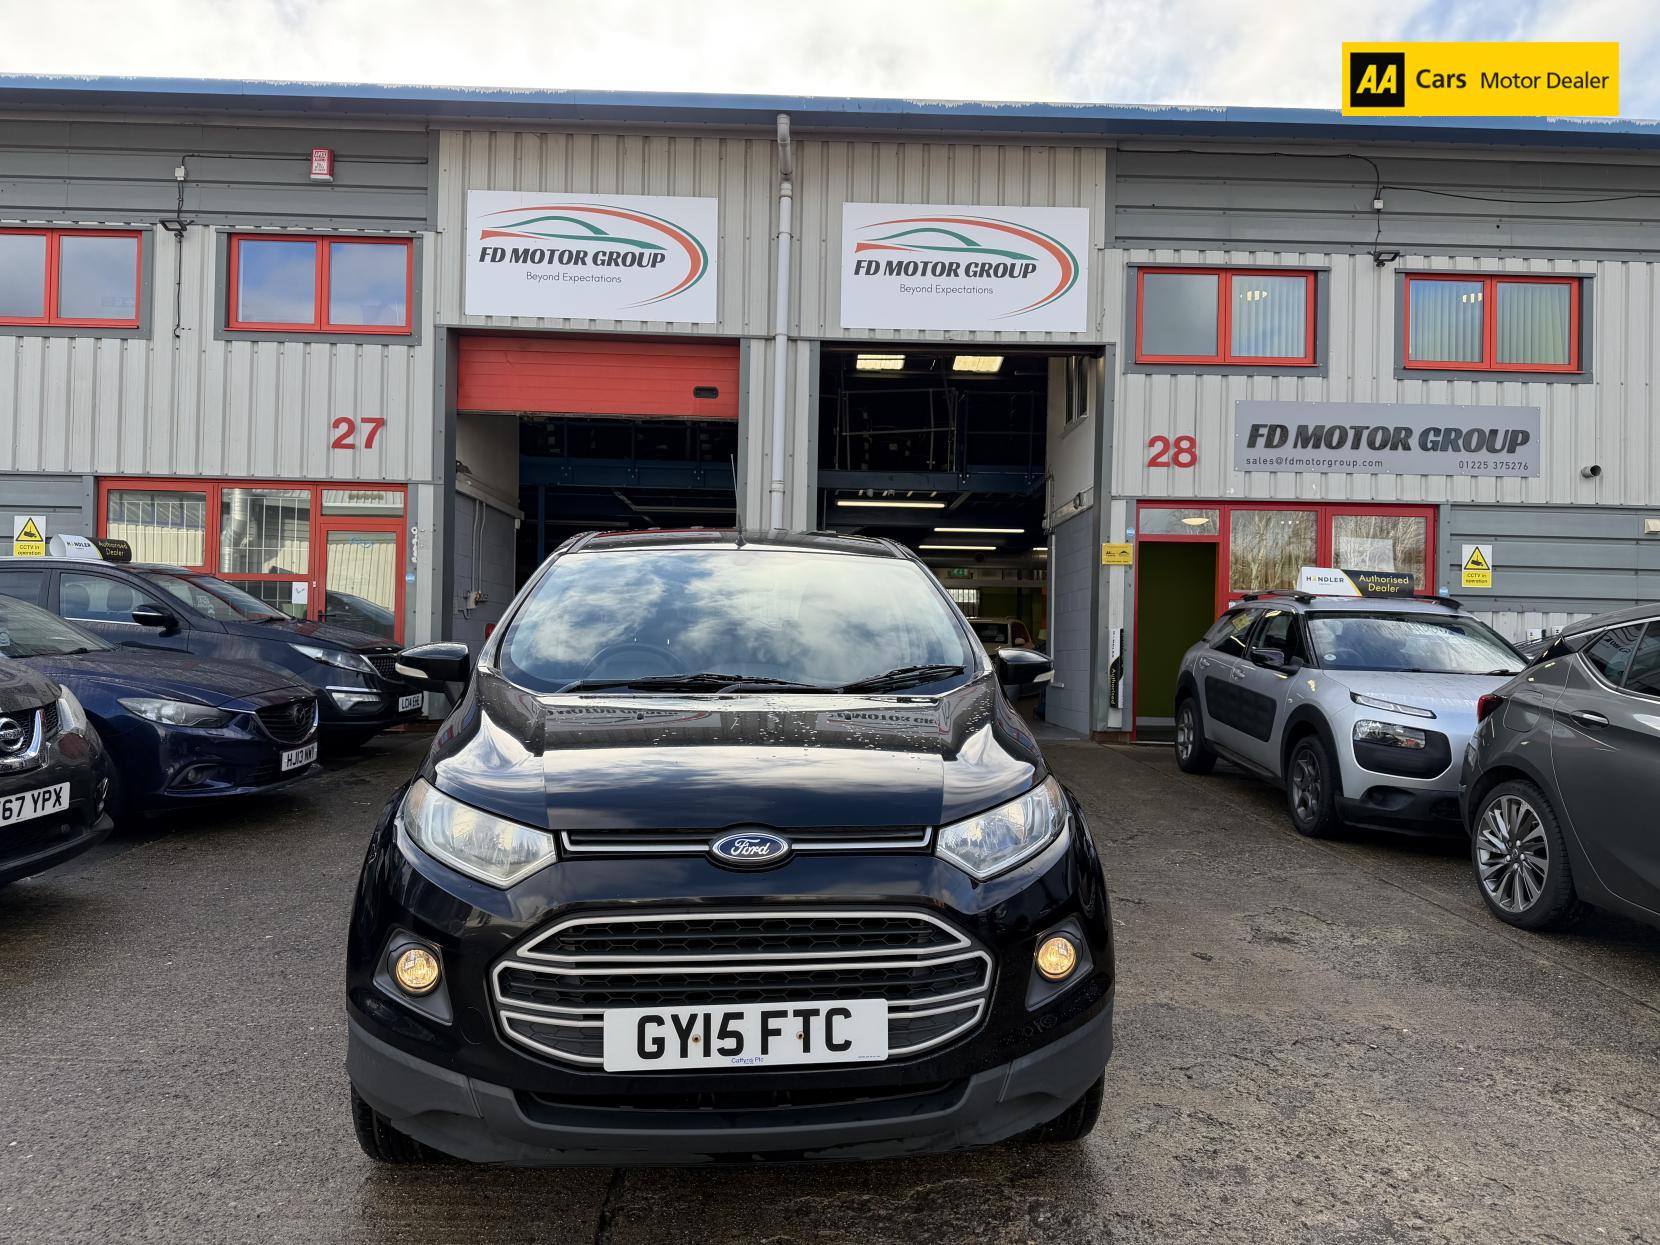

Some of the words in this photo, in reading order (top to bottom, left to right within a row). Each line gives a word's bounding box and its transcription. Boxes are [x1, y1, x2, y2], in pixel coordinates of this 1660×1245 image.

[479, 246, 505, 262] FD
[510, 248, 587, 266] MOTOR
[592, 251, 666, 269] GROUP
[526, 271, 560, 283] Beyond
[563, 272, 622, 284] Expectations
[854, 259, 880, 276] FD
[884, 261, 960, 278] MOTOR
[964, 262, 1037, 279] GROUP
[900, 284, 933, 295] Beyond
[936, 284, 994, 296] Expectations
[331, 416, 385, 449] 27
[1246, 423, 1289, 449] FD
[1293, 424, 1413, 451] MOTOR
[1418, 426, 1531, 454] GROUP
[1147, 435, 1197, 468] 28
[1246, 456, 1383, 468] sales@fdmotorgroup.com
[1458, 459, 1489, 470] 01225
[1493, 460, 1529, 471] 375276
[105, 548, 124, 557] Dealer
[1359, 574, 1409, 585] Authorised
[1368, 583, 1400, 593] Dealer
[0, 796, 25, 821] 67
[31, 786, 63, 813] YPX
[731, 838, 771, 855] Ford
[637, 1011, 745, 1060] GY15
[760, 1007, 853, 1056] FTC
